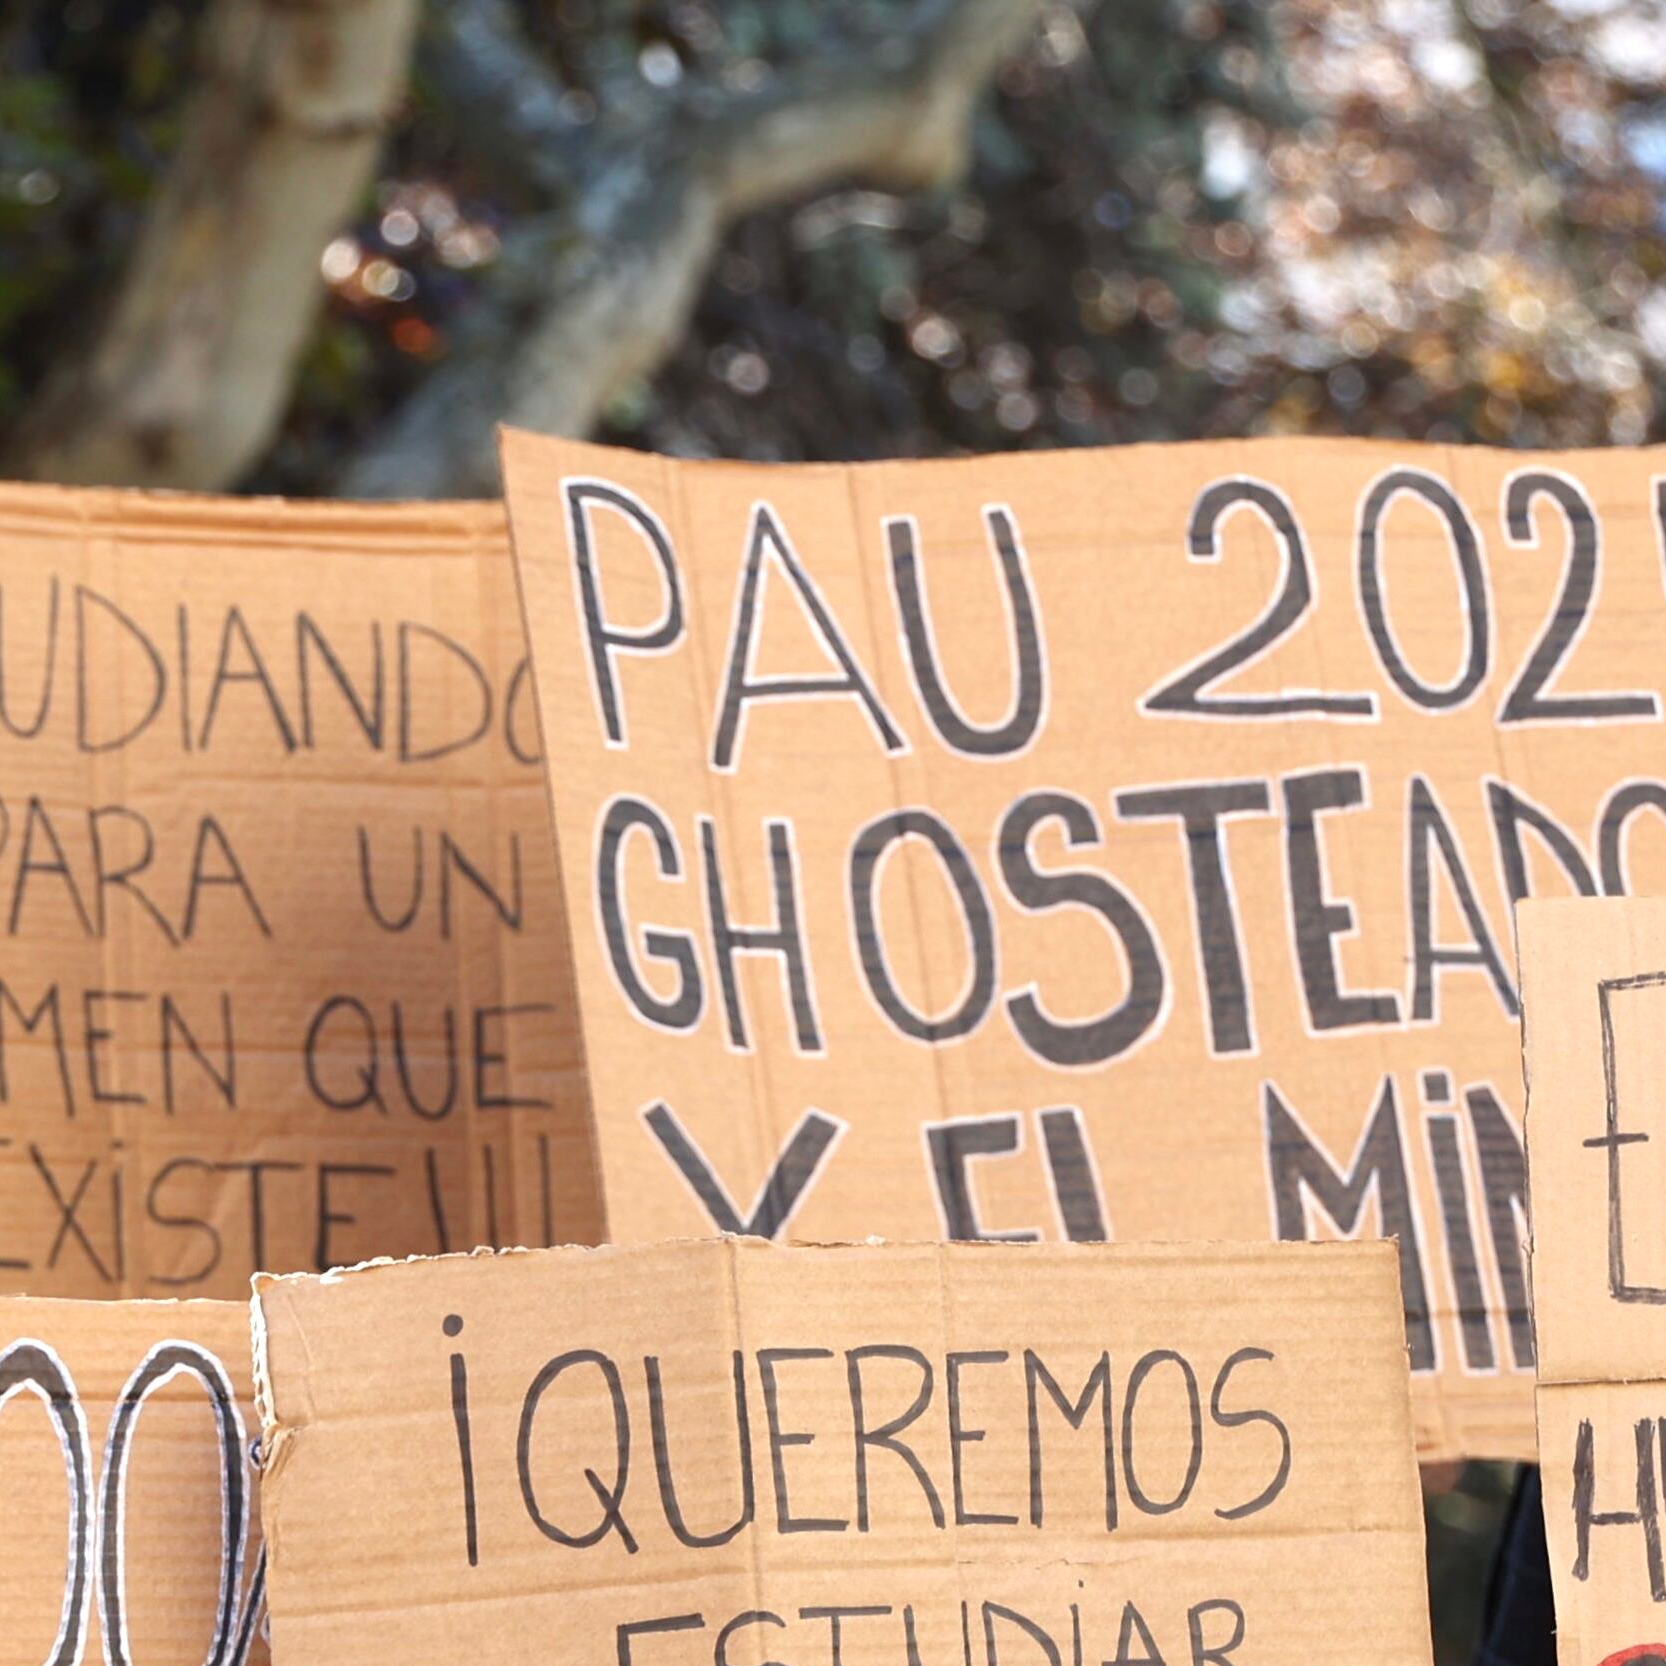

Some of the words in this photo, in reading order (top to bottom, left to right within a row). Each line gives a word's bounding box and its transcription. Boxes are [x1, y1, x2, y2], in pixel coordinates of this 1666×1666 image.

[561, 476, 1050, 771] PAU
[358, 823, 522, 941] UN
[302, 994, 557, 1121] QUE
[441, 1315, 1292, 1567] ¡QUEREMOS
